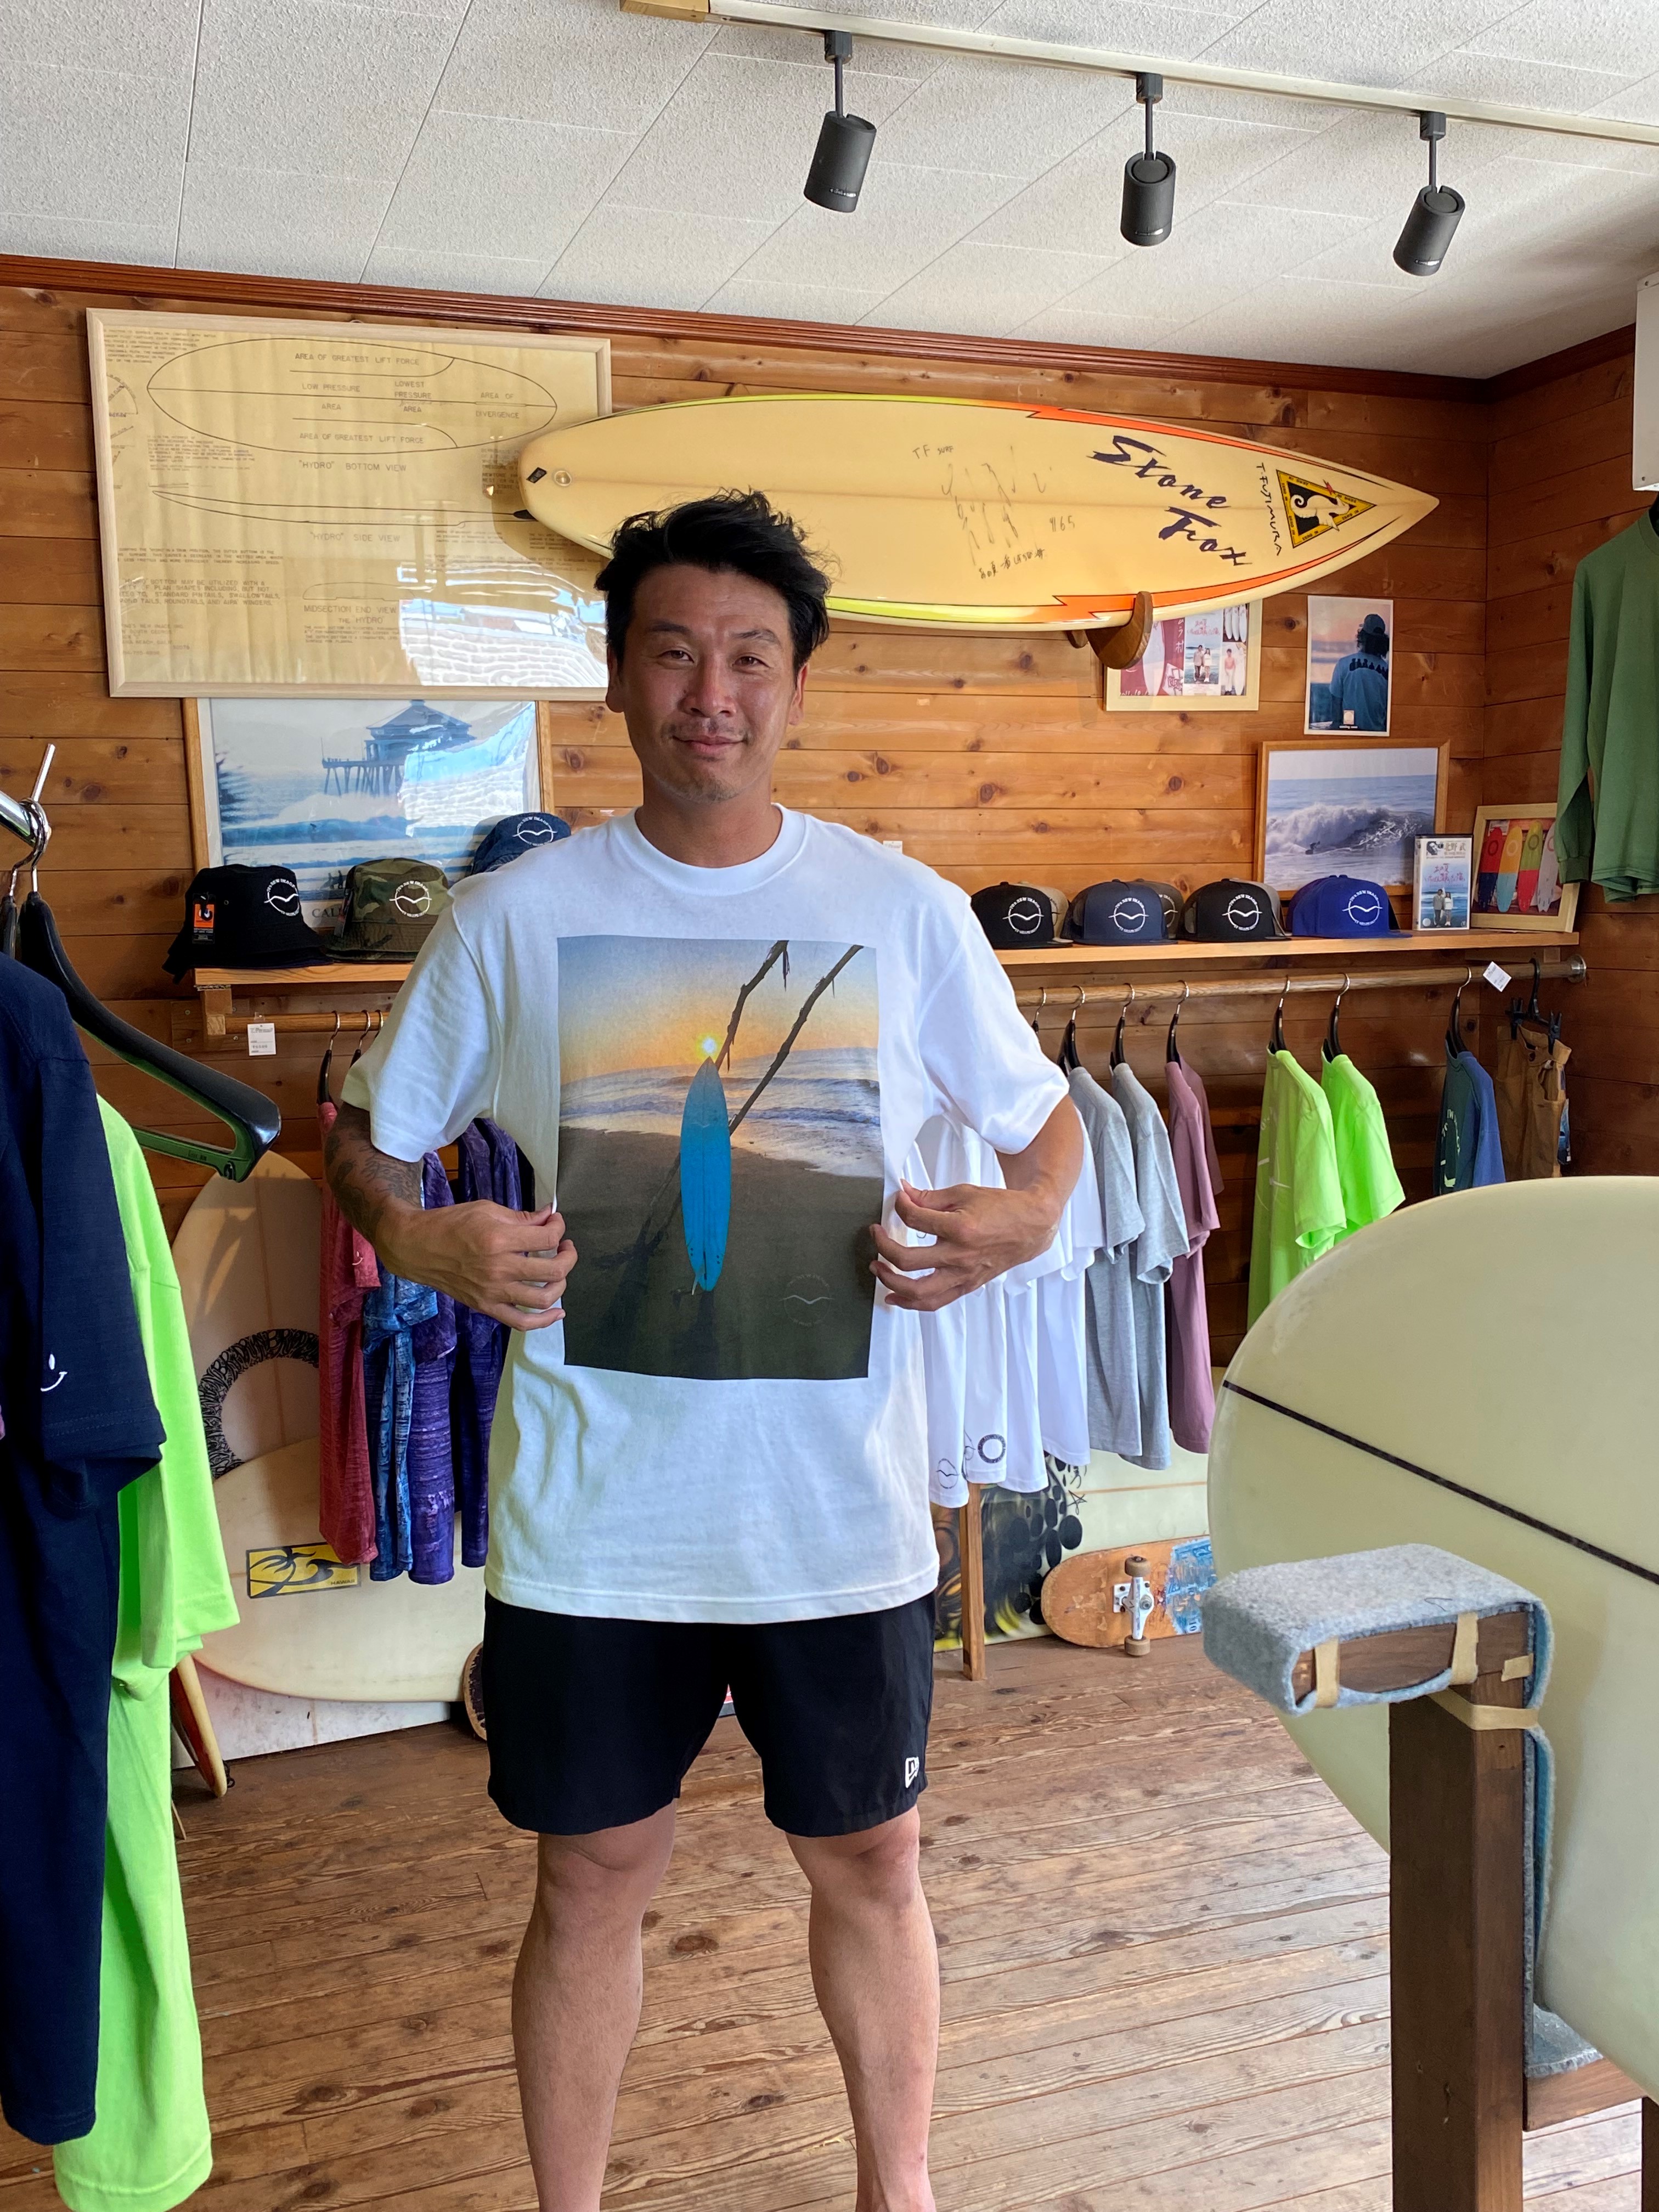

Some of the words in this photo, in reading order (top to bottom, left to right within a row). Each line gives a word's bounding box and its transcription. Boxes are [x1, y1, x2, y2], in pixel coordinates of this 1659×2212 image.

[332, 354, 369, 363] GREATEST
[323, 383, 360, 392] PRESSURE
[476, 411, 520, 419] DIVERGENCE
[346, 462, 380, 471] BOTTOM
[304, 605, 352, 613] MIDSECTION
